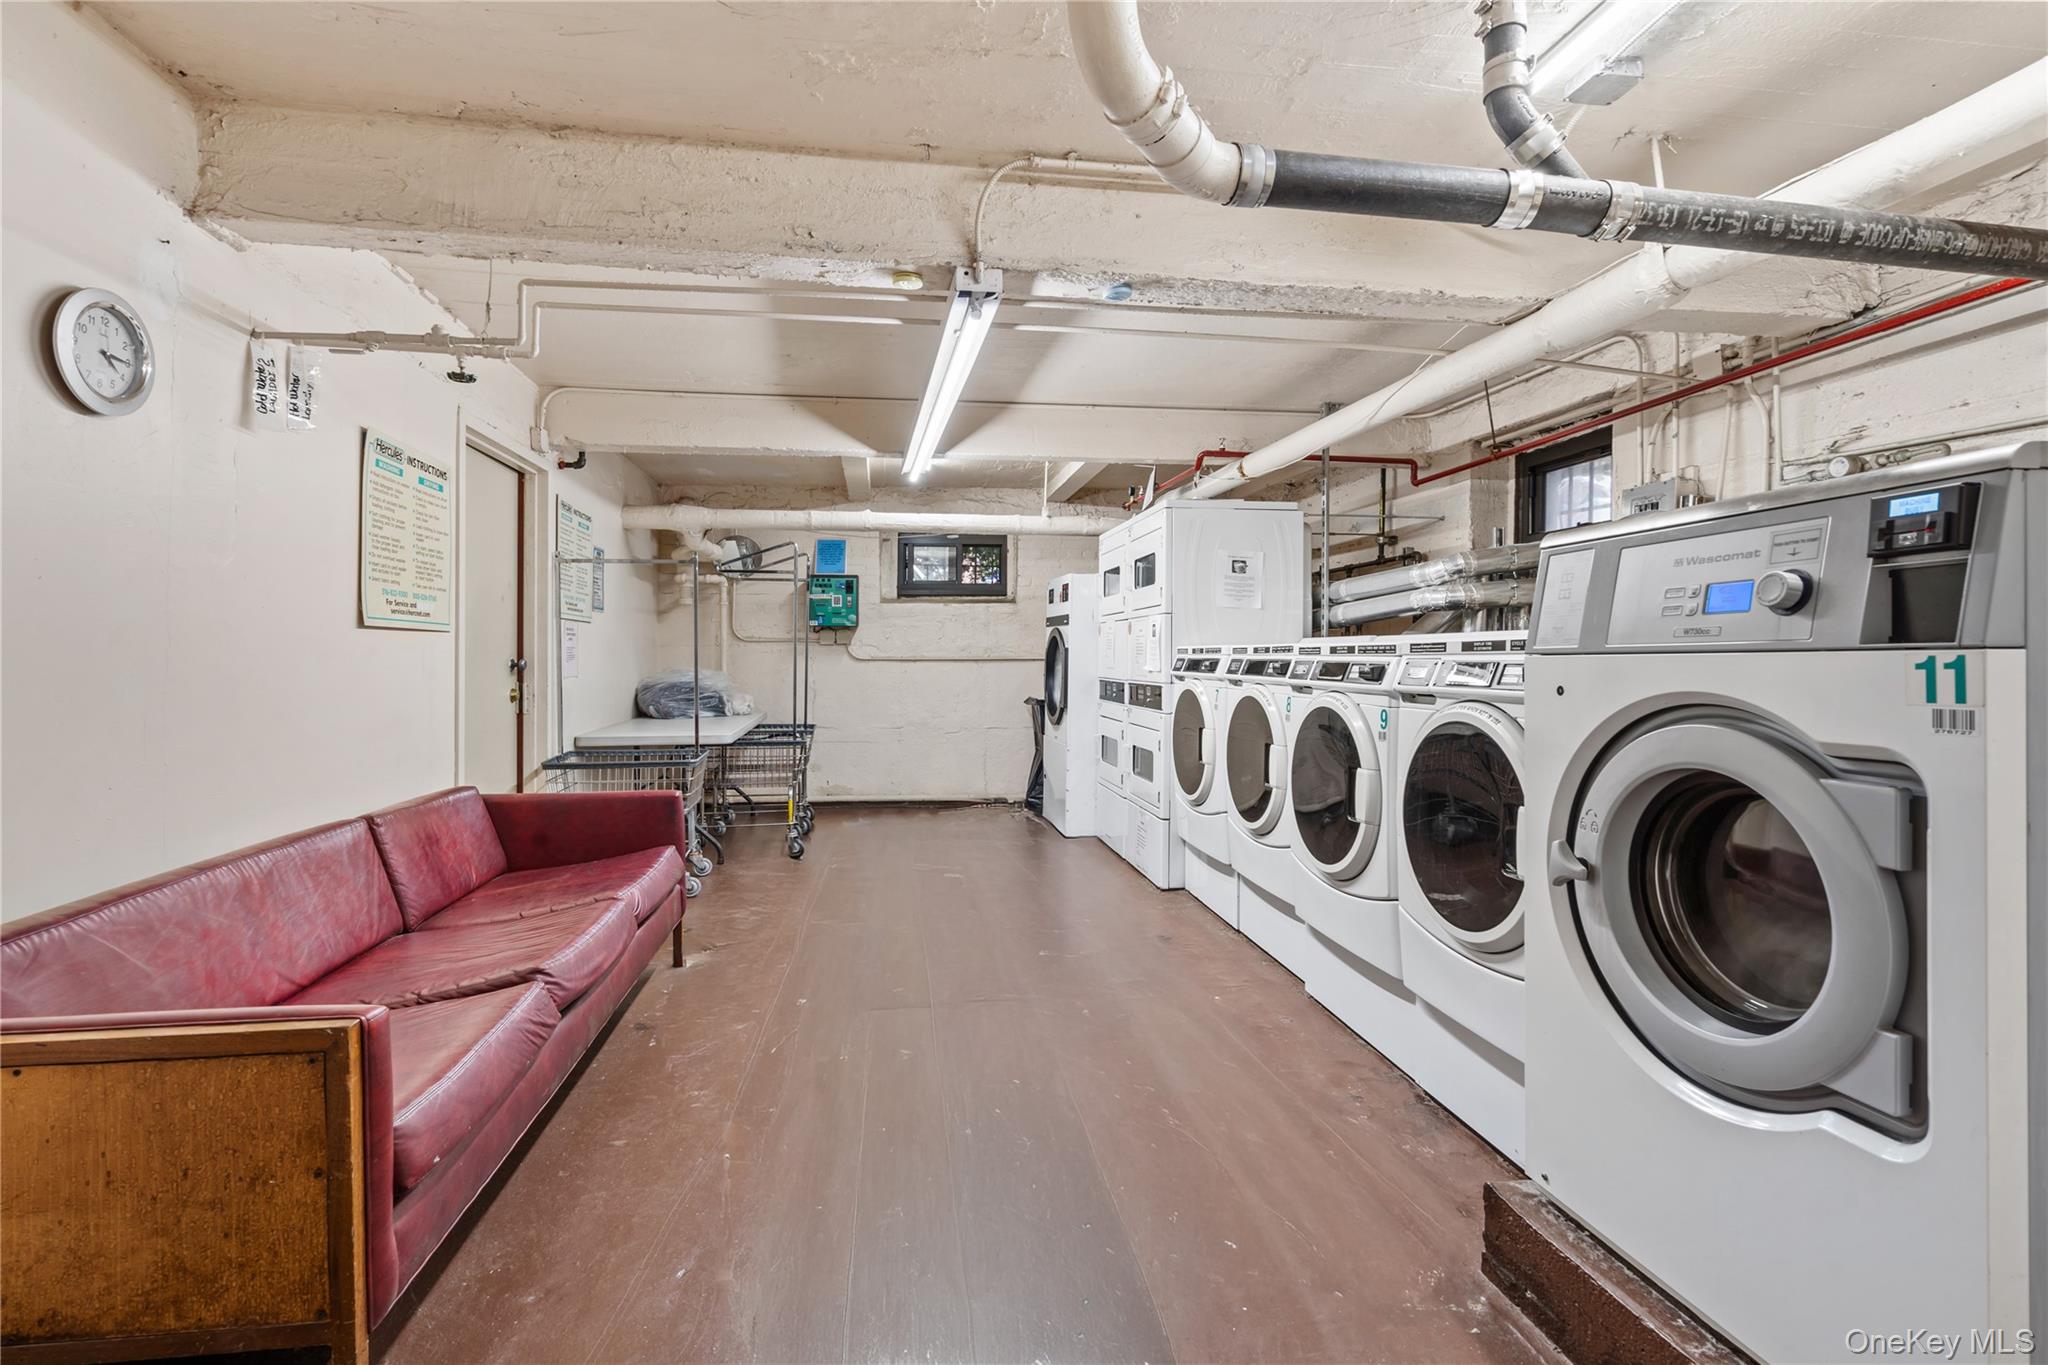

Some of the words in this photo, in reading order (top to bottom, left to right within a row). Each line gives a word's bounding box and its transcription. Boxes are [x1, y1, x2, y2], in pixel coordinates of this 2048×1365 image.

[78, 322, 87, 334] 10
[88, 315, 95, 326] 11
[101, 316, 109, 328] 12
[255, 393, 268, 414] Cold
[289, 402, 300, 417] Hot
[375, 438, 403, 462] Hercules
[407, 455, 448, 481] INSTRUCTIONS
[1686, 549, 1762, 566] Wascomat
[1915, 654, 1967, 704] 11
[1286, 696, 1292, 712] 8
[1380, 709, 1388, 730] 9
